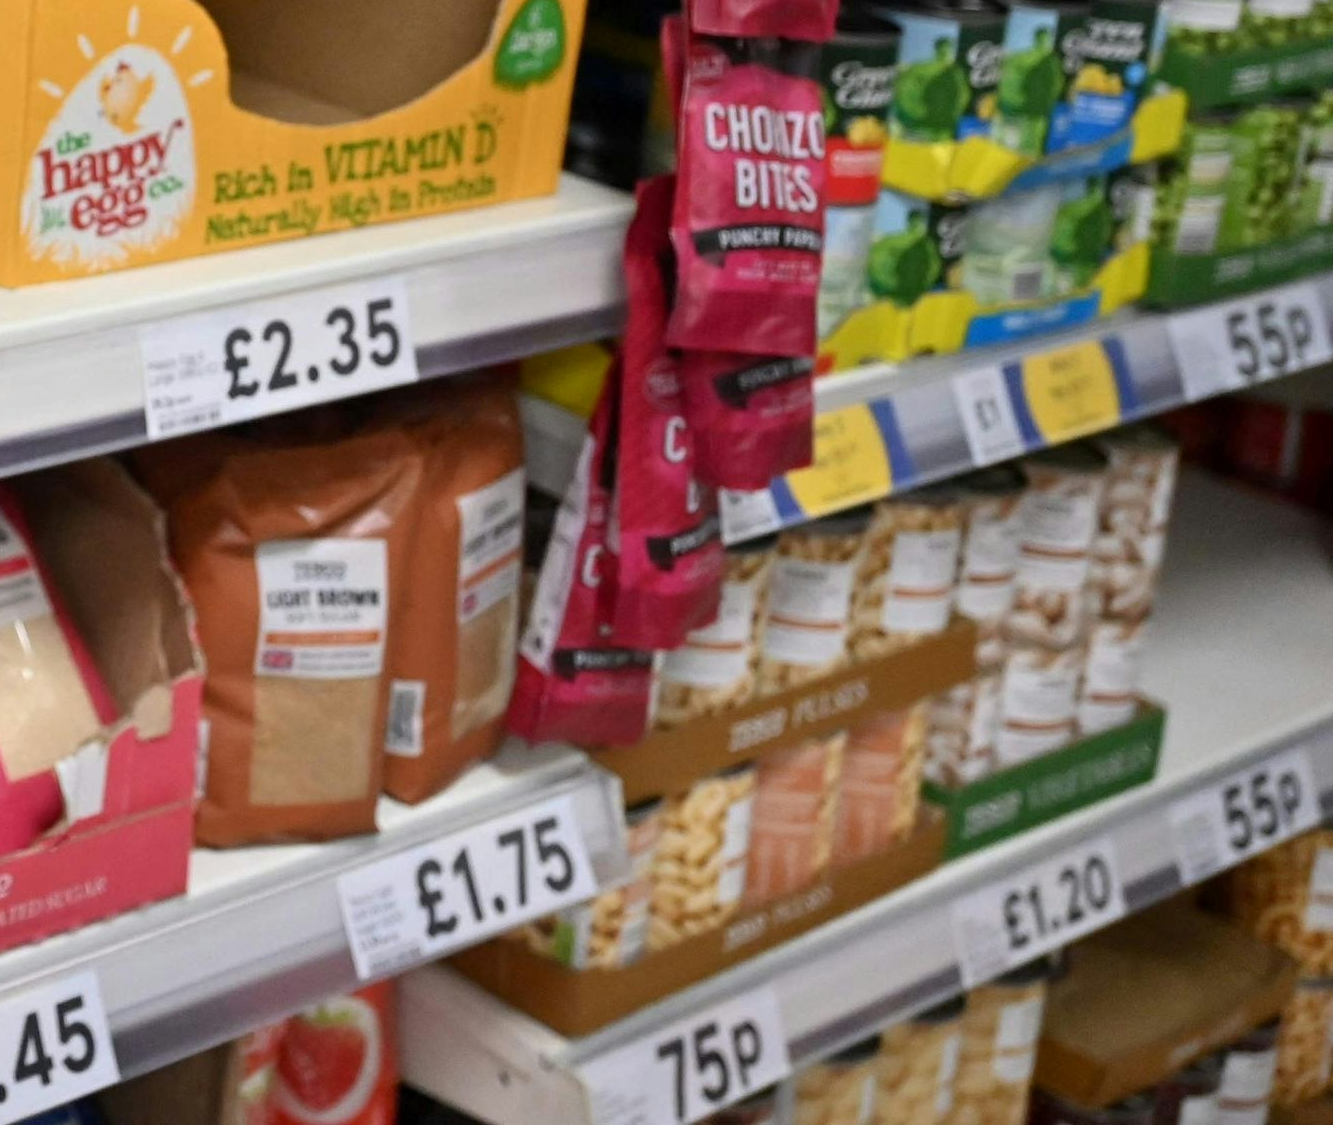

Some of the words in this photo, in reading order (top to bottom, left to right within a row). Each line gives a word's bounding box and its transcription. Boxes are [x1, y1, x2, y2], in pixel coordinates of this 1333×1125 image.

[36, 117, 185, 201] happy
[55, 130, 93, 157] the
[212, 167, 278, 206] Rich
[323, 128, 468, 185] VITAMIN
[473, 122, 499, 166] D
[68, 173, 151, 239] egg
[204, 200, 323, 247] Naturally
[327, 191, 383, 231] High
[415, 175, 498, 208] Protein
[735, 158, 818, 213] BITES
[224, 297, 401, 400] £2.35
[1226, 302, 1314, 376] 55p
[266, 589, 312, 609] LIGHT
[317, 588, 380, 609] BROWN
[1224, 771, 1302, 850] 55p
[38, 876, 109, 916] SUGAR
[416, 815, 579, 940] £1.75
[1004, 854, 1112, 949] £1.20
[656, 1015, 763, 1122] 75p
